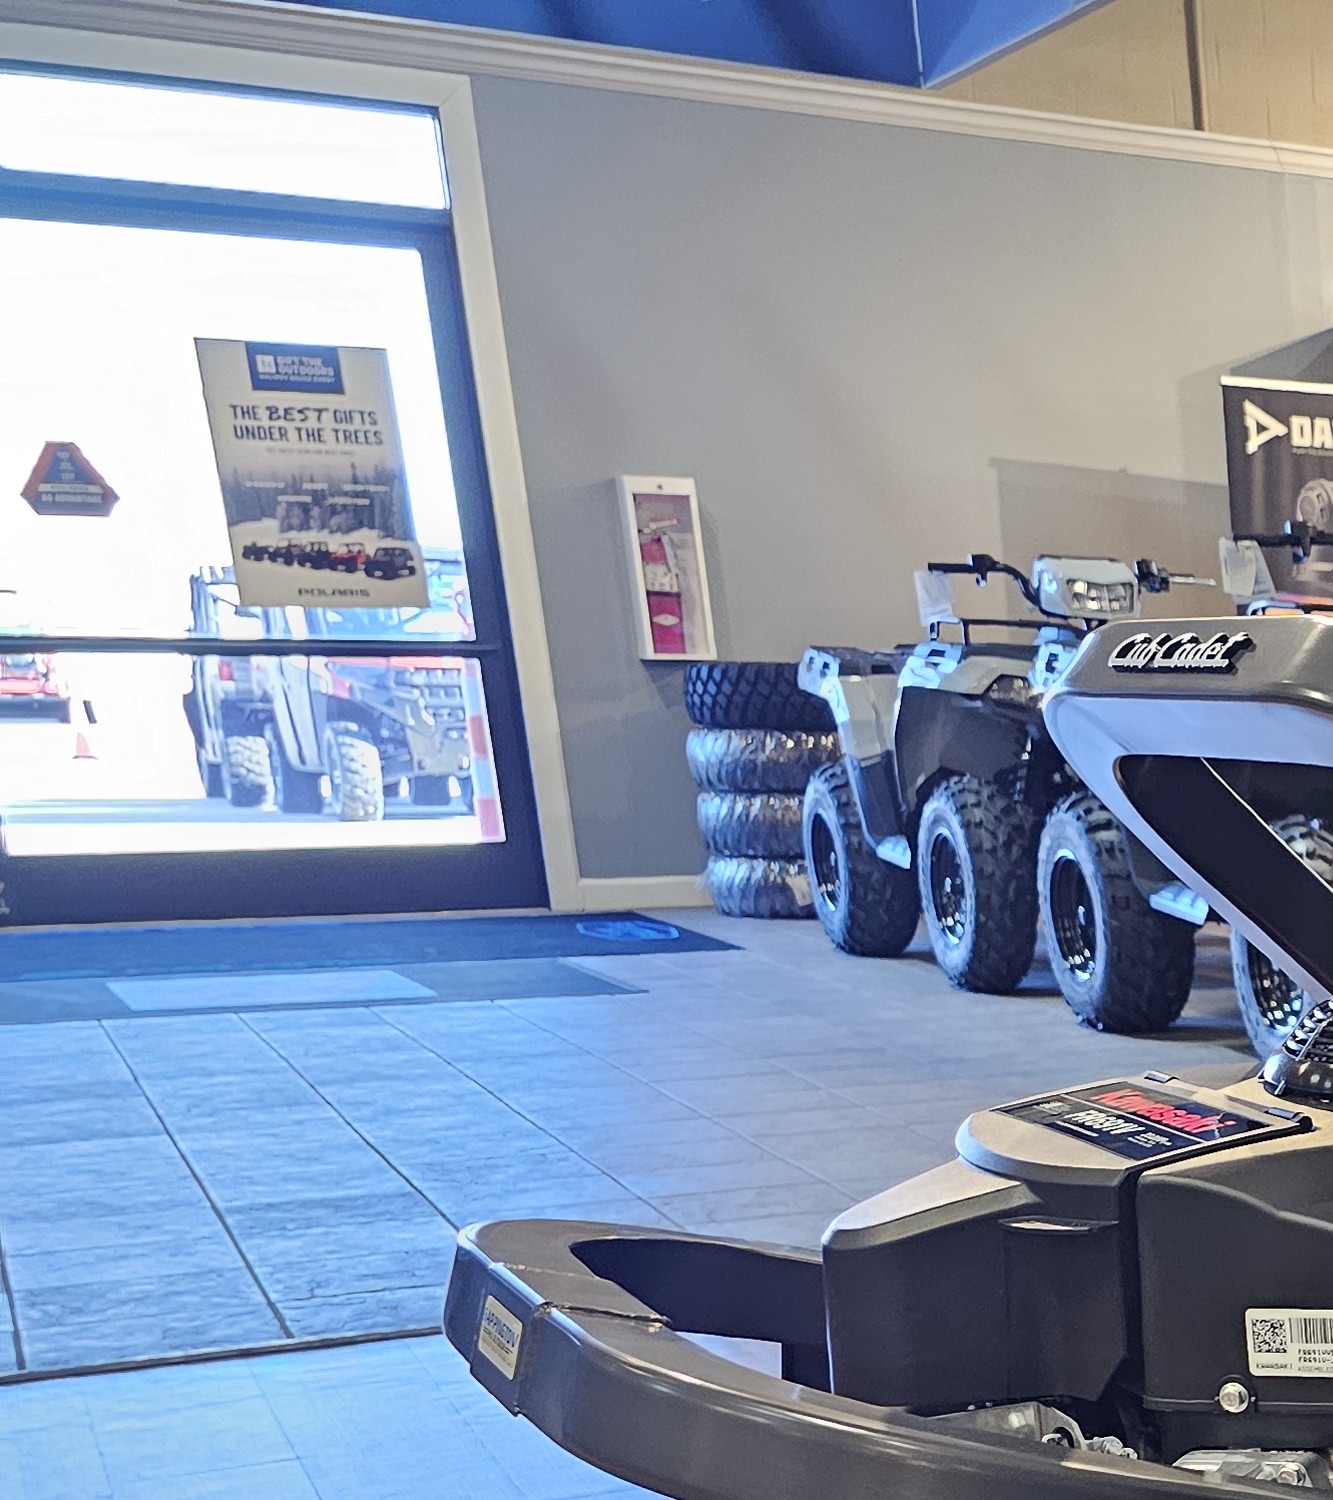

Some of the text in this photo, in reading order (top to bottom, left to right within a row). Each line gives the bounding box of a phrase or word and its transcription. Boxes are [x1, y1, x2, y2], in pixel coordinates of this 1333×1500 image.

[229, 403, 378, 426] THE BEST GIFTS
[232, 424, 384, 446] UNDER THE TREES
[1108, 631, 1251, 669] Cub Cadet
